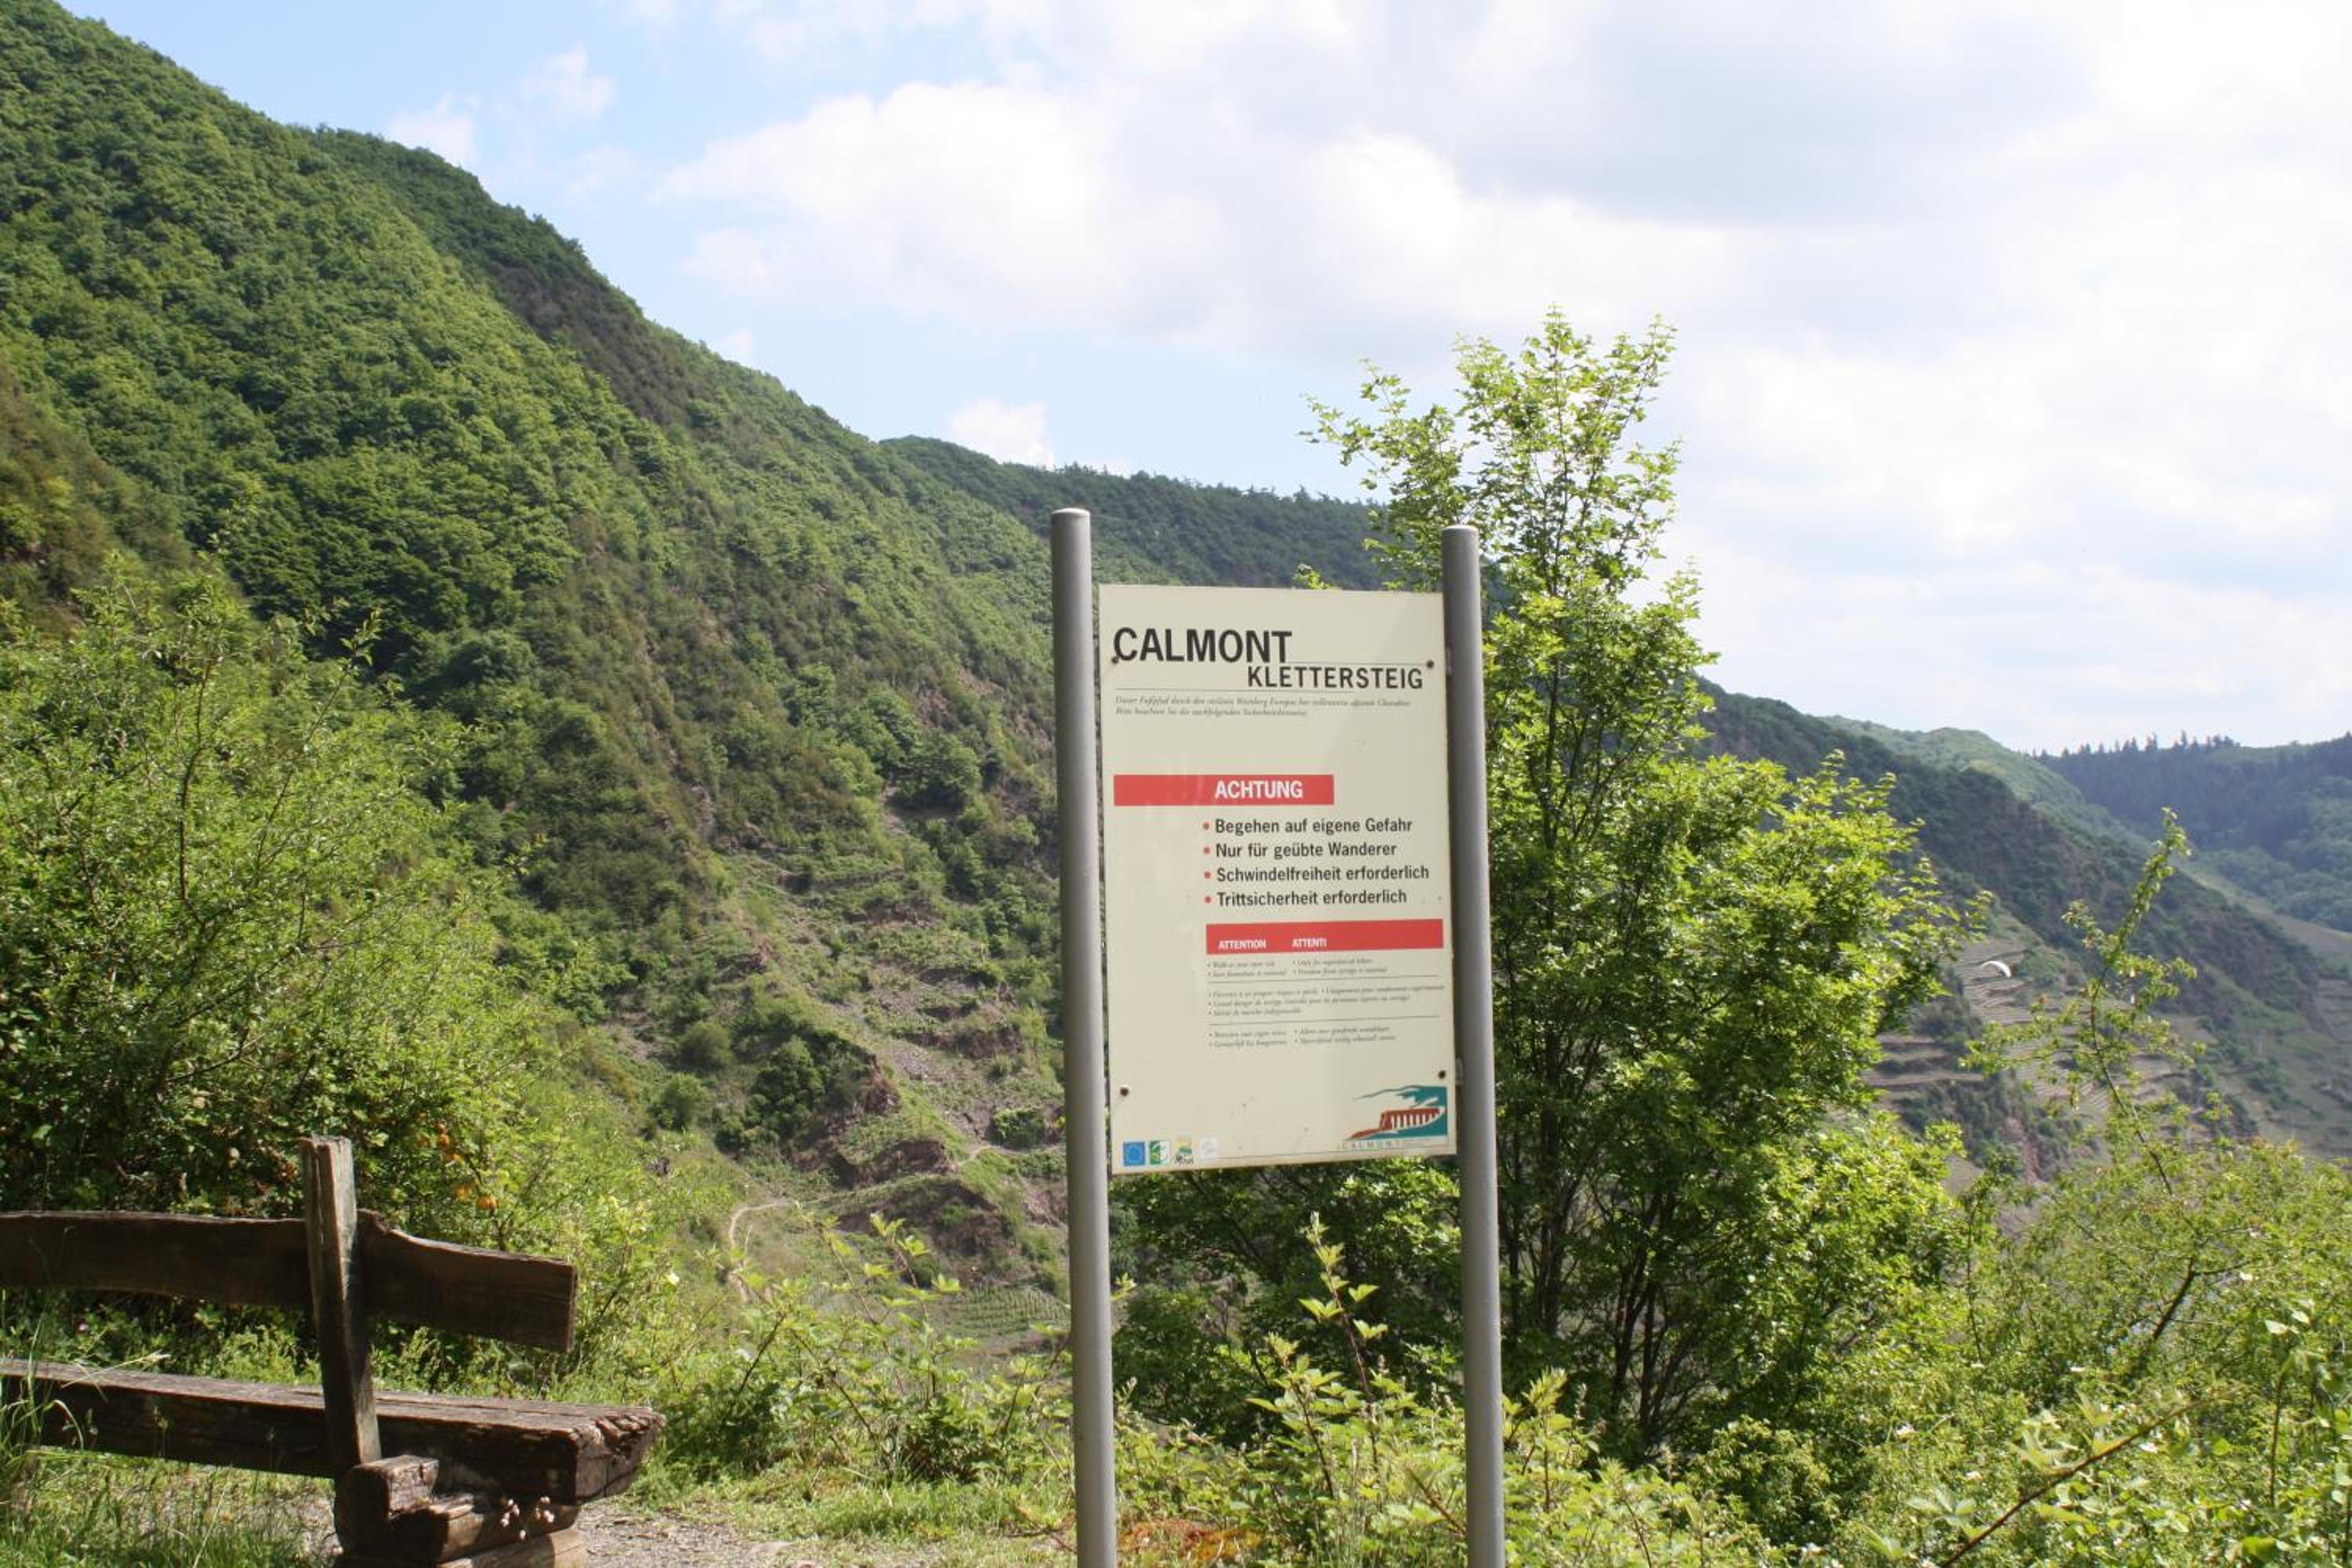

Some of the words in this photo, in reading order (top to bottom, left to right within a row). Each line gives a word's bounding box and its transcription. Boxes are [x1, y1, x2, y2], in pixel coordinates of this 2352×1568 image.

[1112, 626, 1292, 663] CALMONT
[1247, 666, 1424, 689] KLETTERSTEIG
[1214, 780, 1304, 799] ACHTUNG
[1215, 818, 1279, 835] Begehen
[1285, 818, 1308, 833] auf
[1312, 818, 1360, 835] eigene
[1365, 818, 1413, 832] Gefahr
[1216, 844, 1243, 858] Nur
[1247, 843, 1269, 857] für
[1273, 843, 1323, 860] geübte
[1328, 842, 1397, 856] Wanderer
[1217, 867, 1341, 882] Schwindelfreiheit
[1345, 866, 1429, 880] erforderlich
[1217, 891, 1319, 906] Trittsicherheit
[1323, 890, 1407, 905] erforderlich
[1218, 939, 1266, 950] ATTENTION
